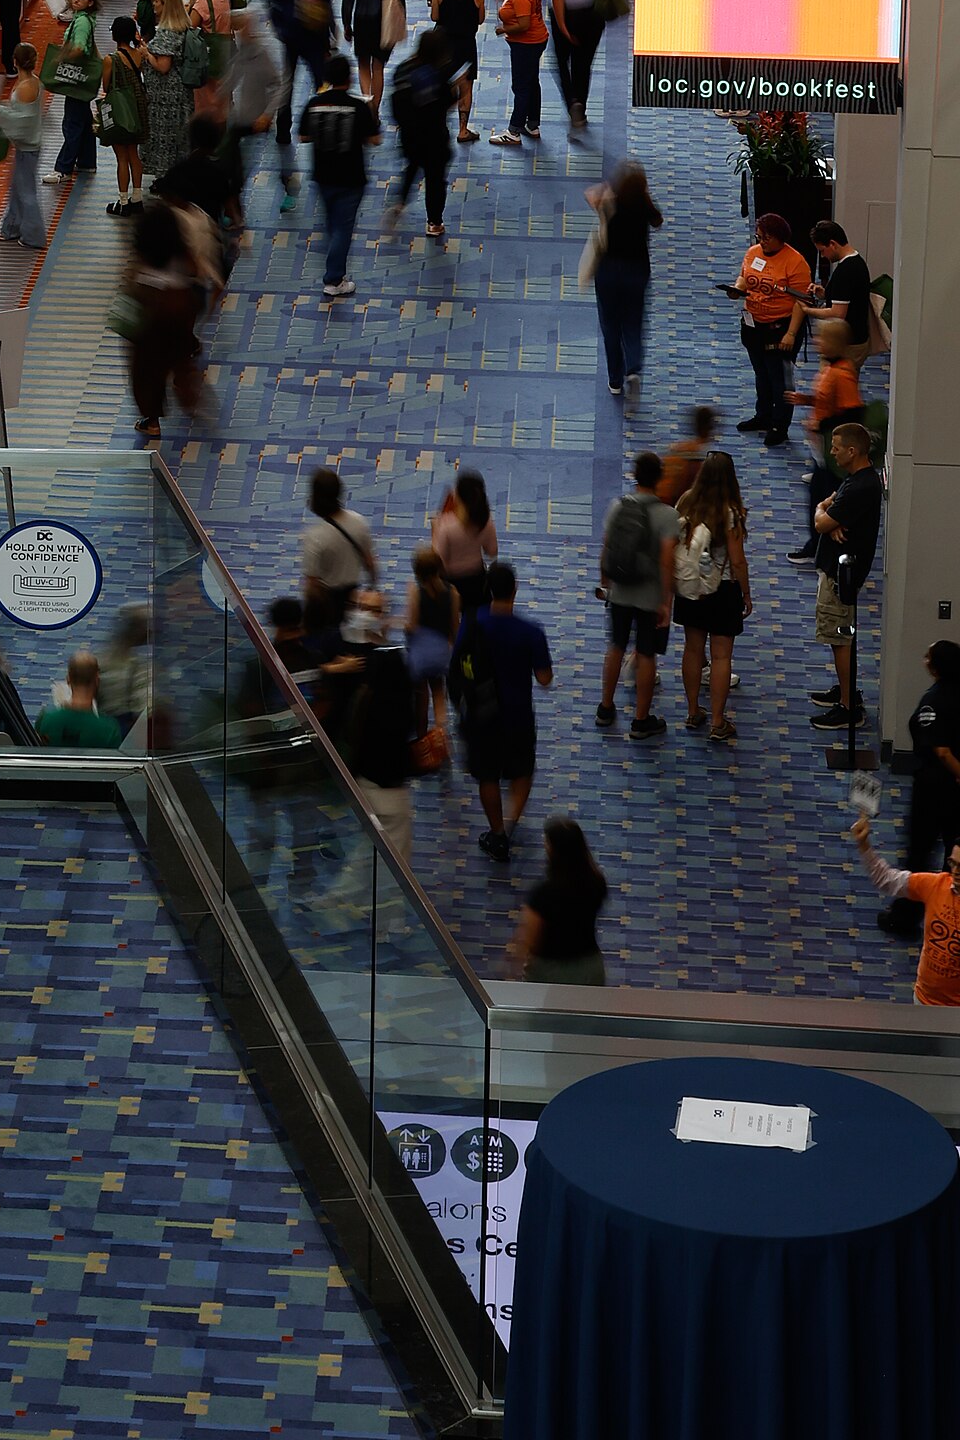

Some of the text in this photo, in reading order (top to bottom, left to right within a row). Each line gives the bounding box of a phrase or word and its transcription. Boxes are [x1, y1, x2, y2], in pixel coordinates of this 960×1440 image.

[649, 74, 876, 100] loc.gov/bookfest
[746, 274, 773, 296] 25
[36, 532, 54, 542] DC
[6, 543, 84, 553] HOLD ON WITH
[10, 552, 80, 562] CONFIDENCE
[470, 1134, 503, 1148] AM
